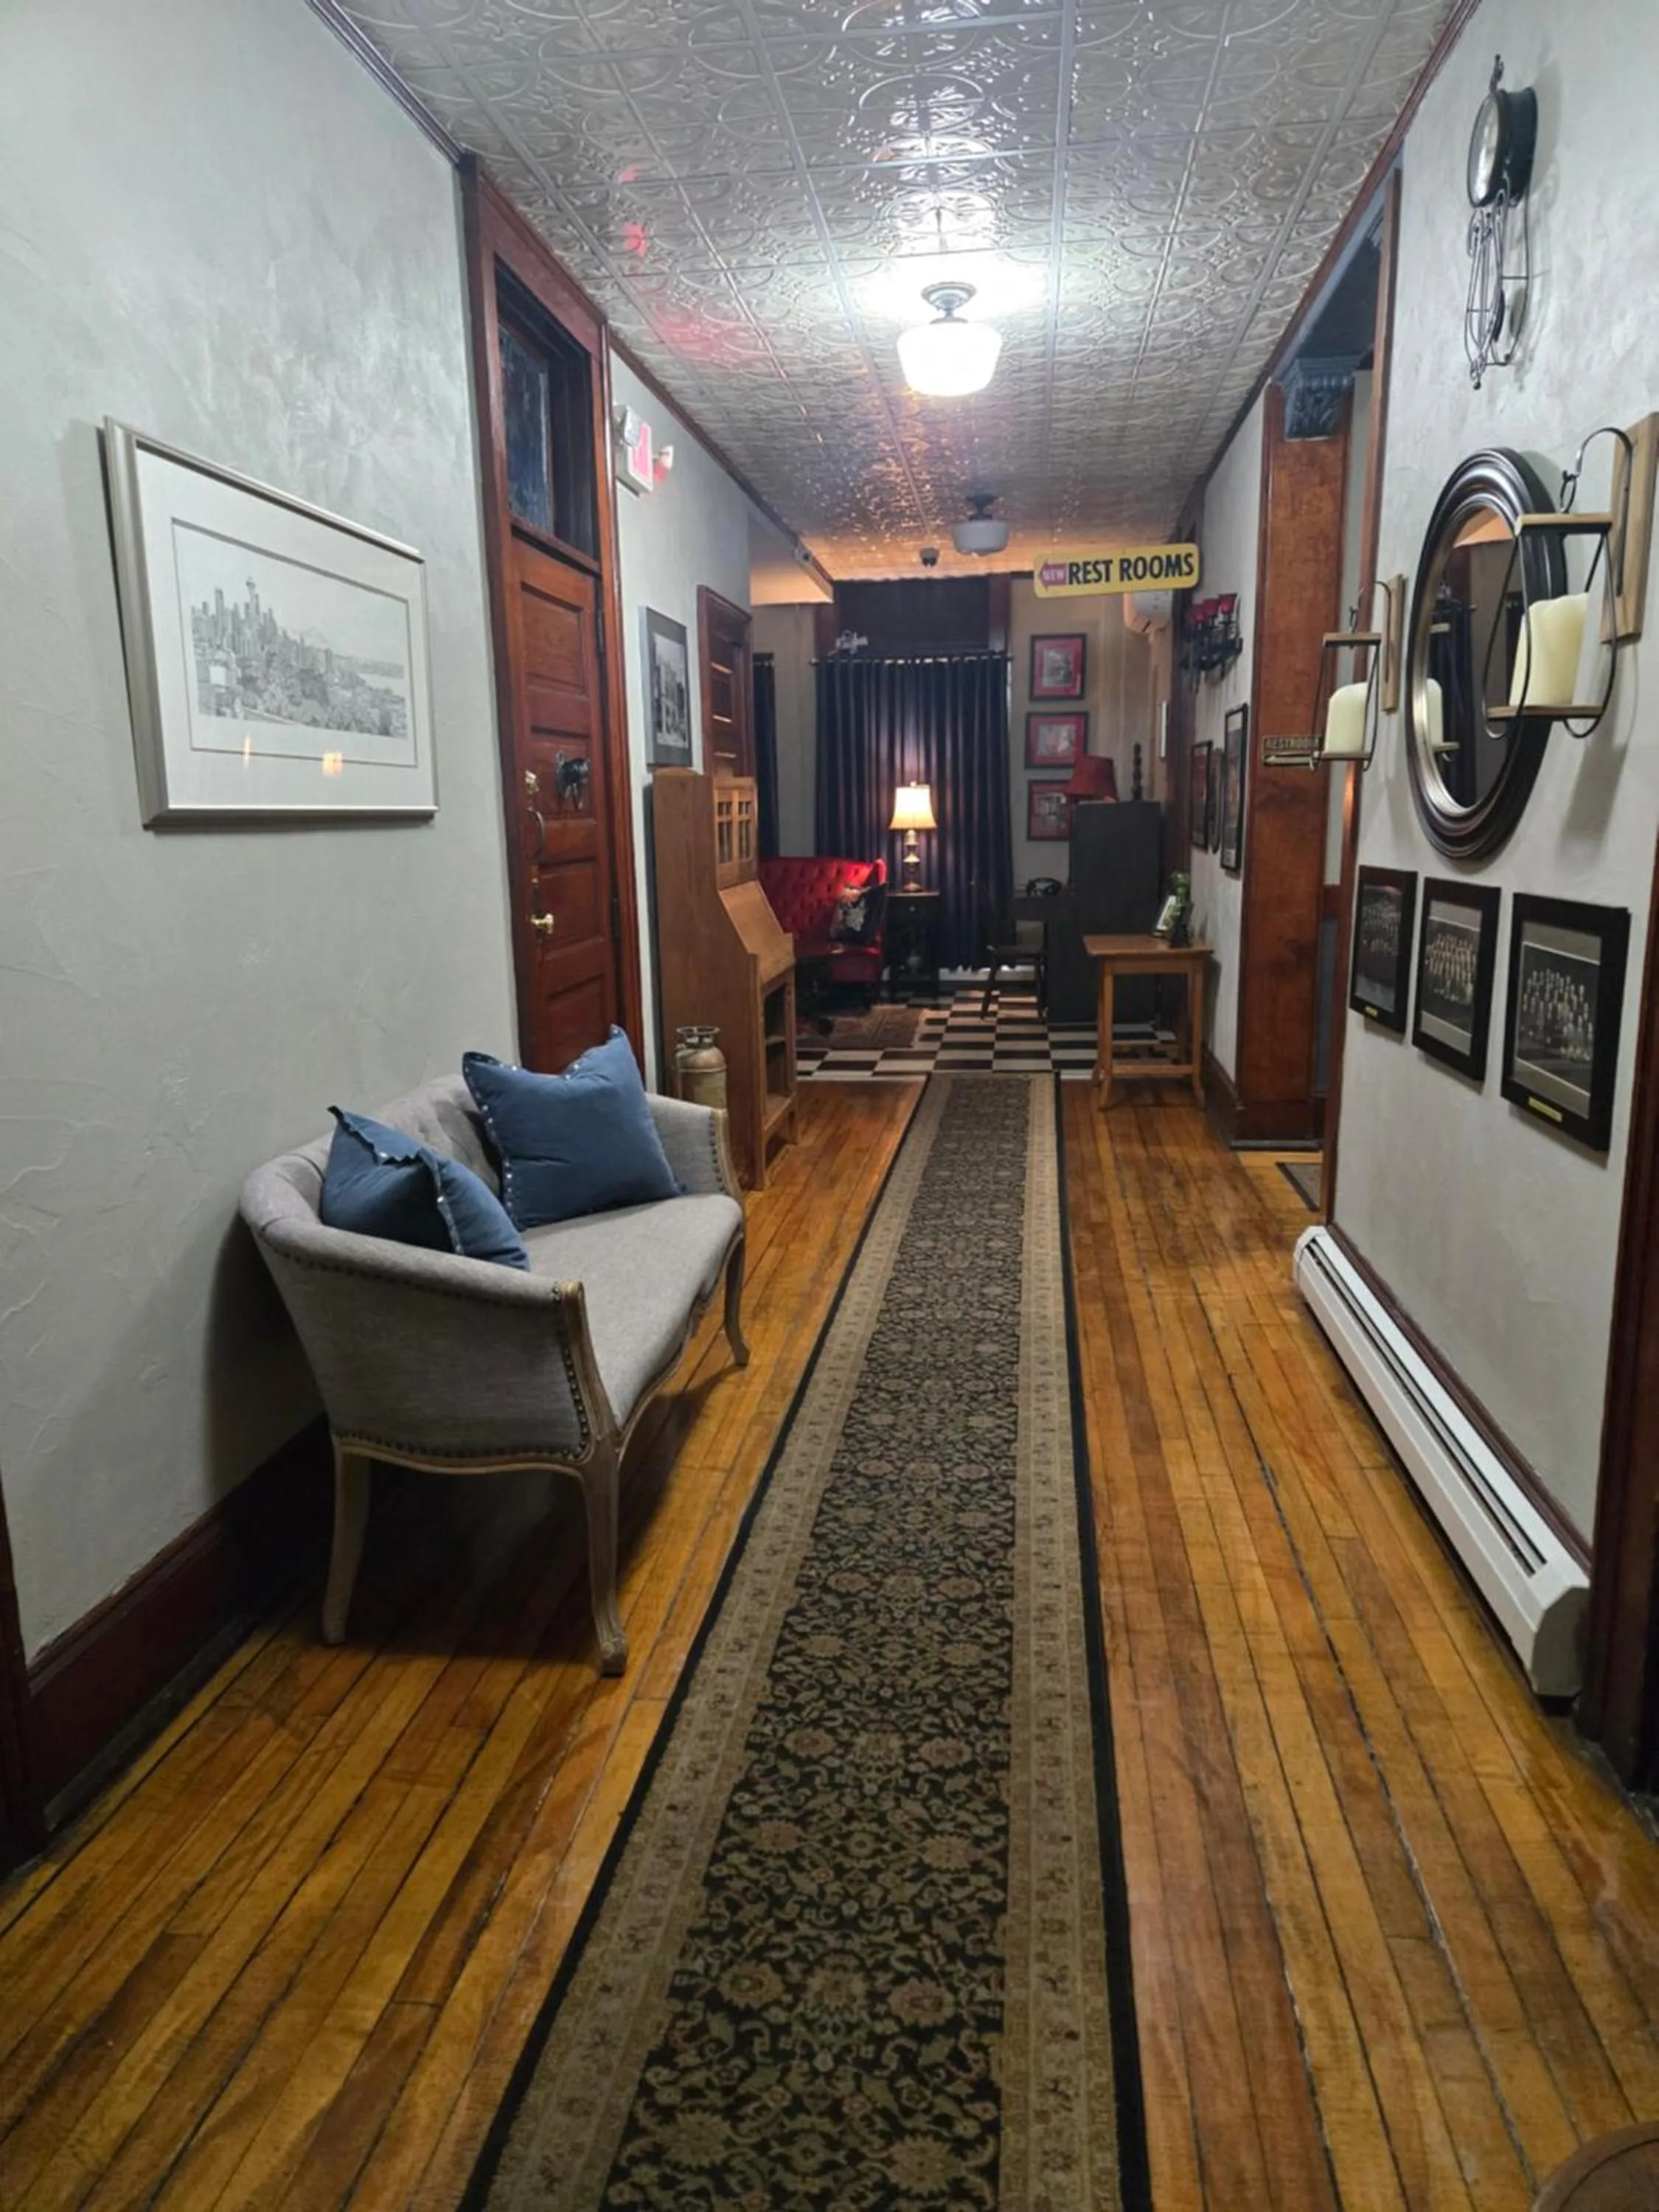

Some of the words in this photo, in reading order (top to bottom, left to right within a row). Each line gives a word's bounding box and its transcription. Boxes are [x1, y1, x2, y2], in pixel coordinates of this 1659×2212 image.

[1042, 568, 1065, 581] NEW
[1068, 560, 1113, 585] REST
[1119, 553, 1194, 582] ROOMS
